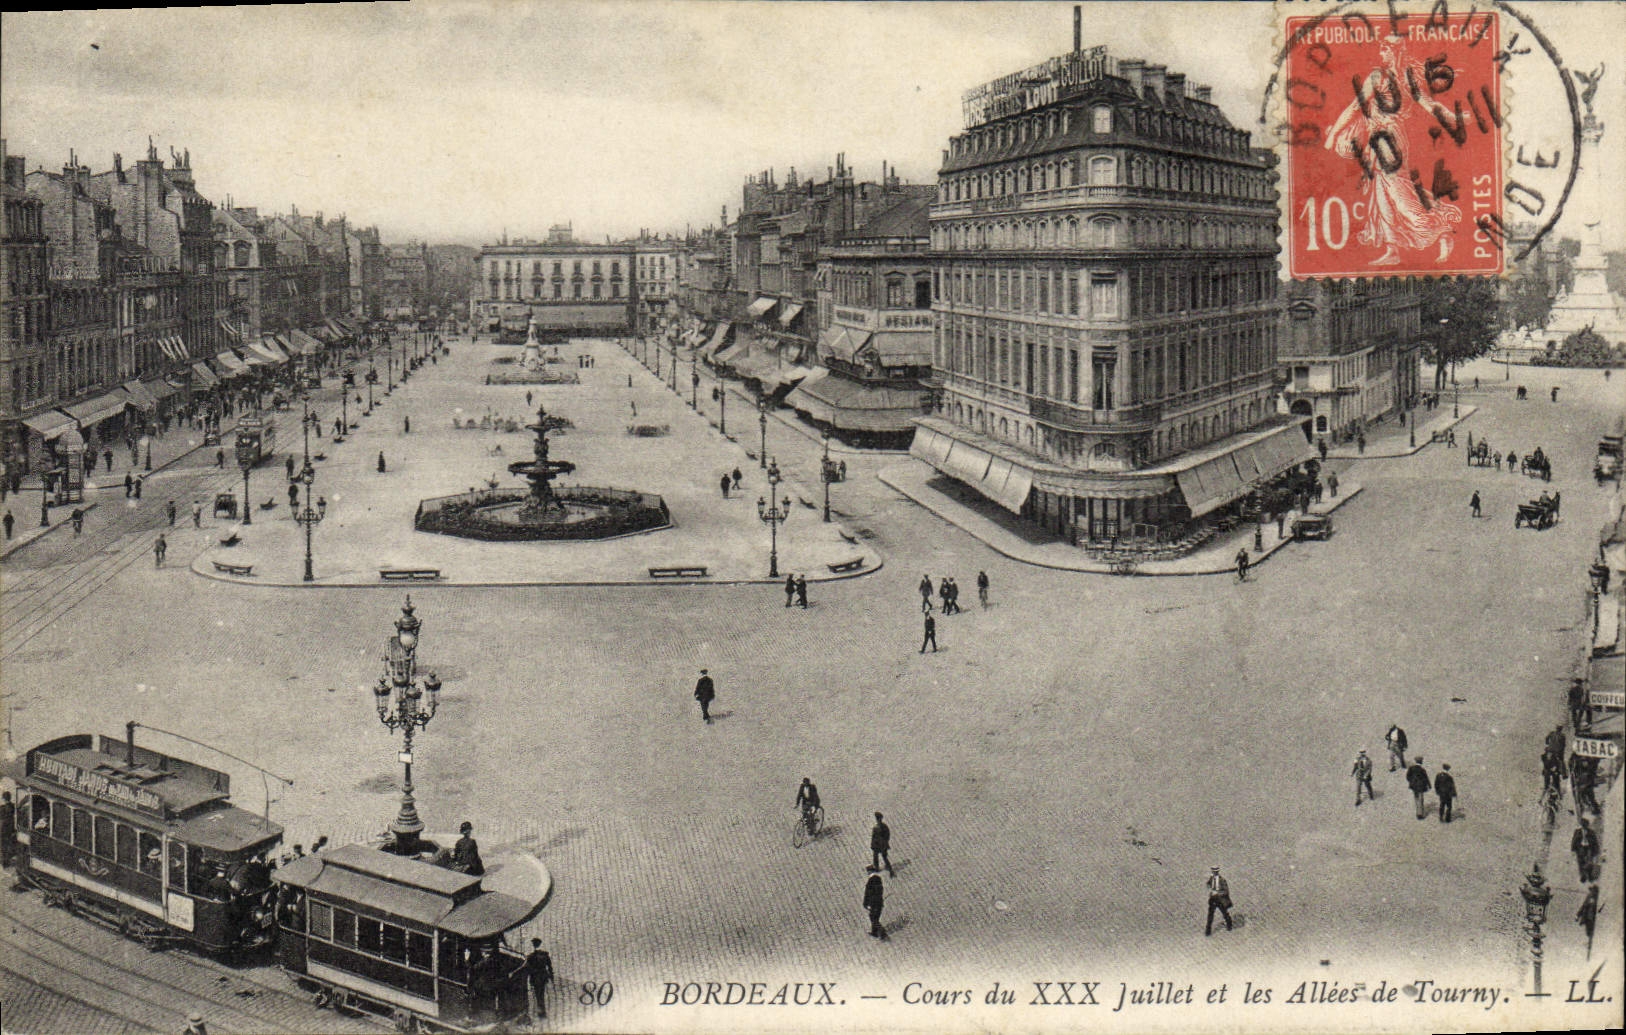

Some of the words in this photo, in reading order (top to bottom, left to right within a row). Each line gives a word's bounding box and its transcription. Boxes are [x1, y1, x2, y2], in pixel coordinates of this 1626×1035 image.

[1060, 56, 1104, 88] GUILLOT
[1025, 80, 1060, 111] LOUIT
[1473, 174, 1492, 259] POSTES
[1576, 739, 1615, 757] TABAC
